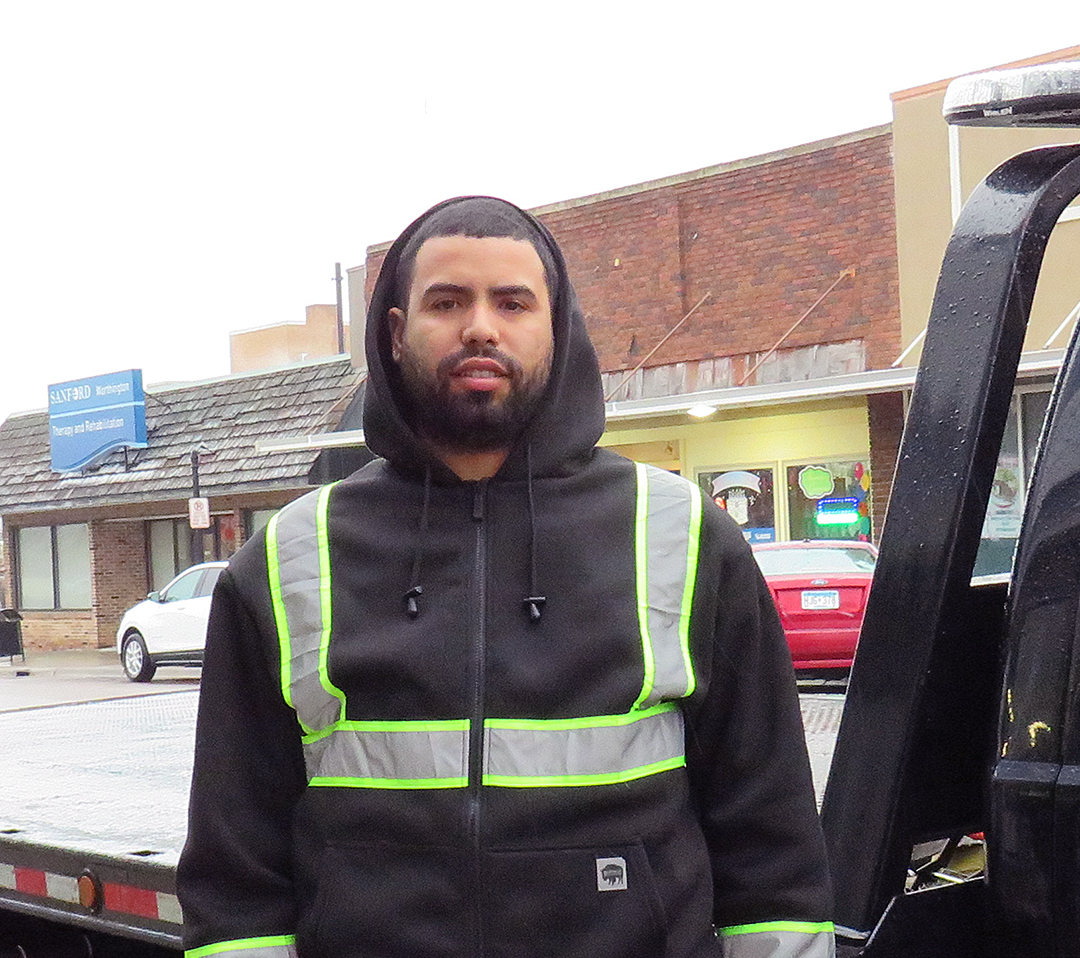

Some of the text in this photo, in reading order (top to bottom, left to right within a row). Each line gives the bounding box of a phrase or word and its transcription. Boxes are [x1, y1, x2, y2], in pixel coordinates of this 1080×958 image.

[50, 385, 91, 404] SANFORD
[52, 419, 124, 437] Therapy and Rehabilitation
